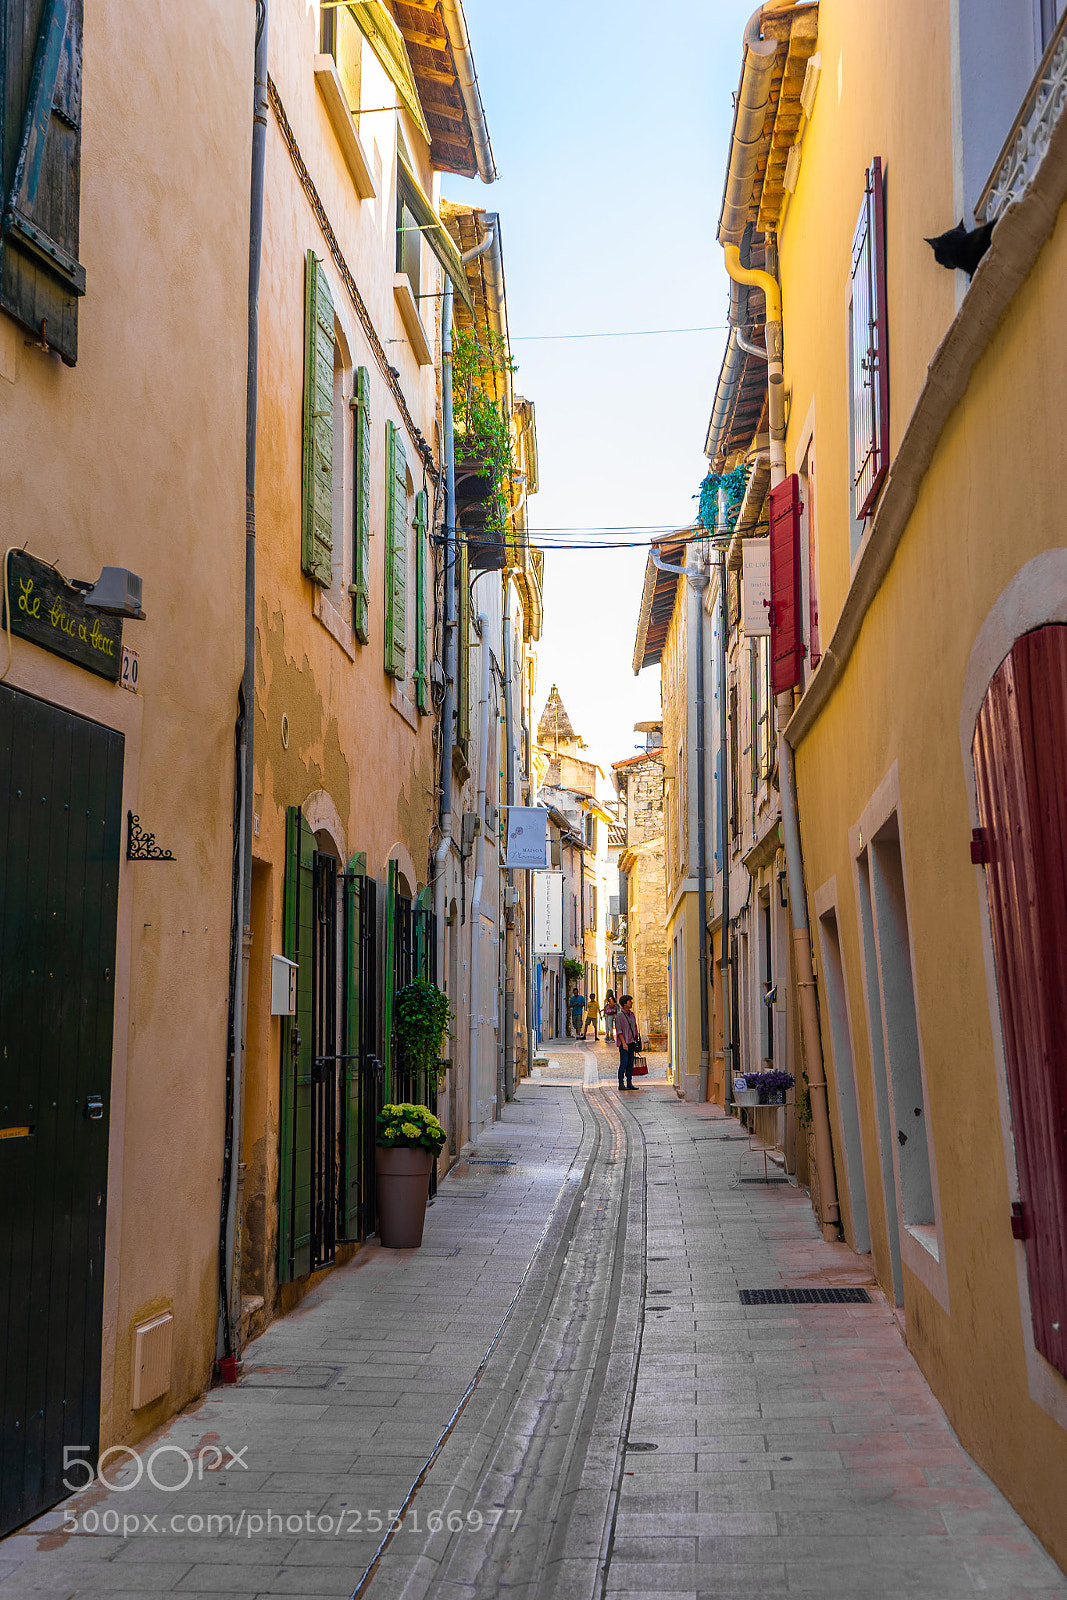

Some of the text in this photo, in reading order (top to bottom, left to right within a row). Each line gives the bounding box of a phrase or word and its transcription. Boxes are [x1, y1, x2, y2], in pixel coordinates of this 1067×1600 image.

[18, 577, 41, 619] Le
[48, 595, 76, 637] bric
[90, 618, 115, 656] brac
[122, 656, 138, 683] 20
